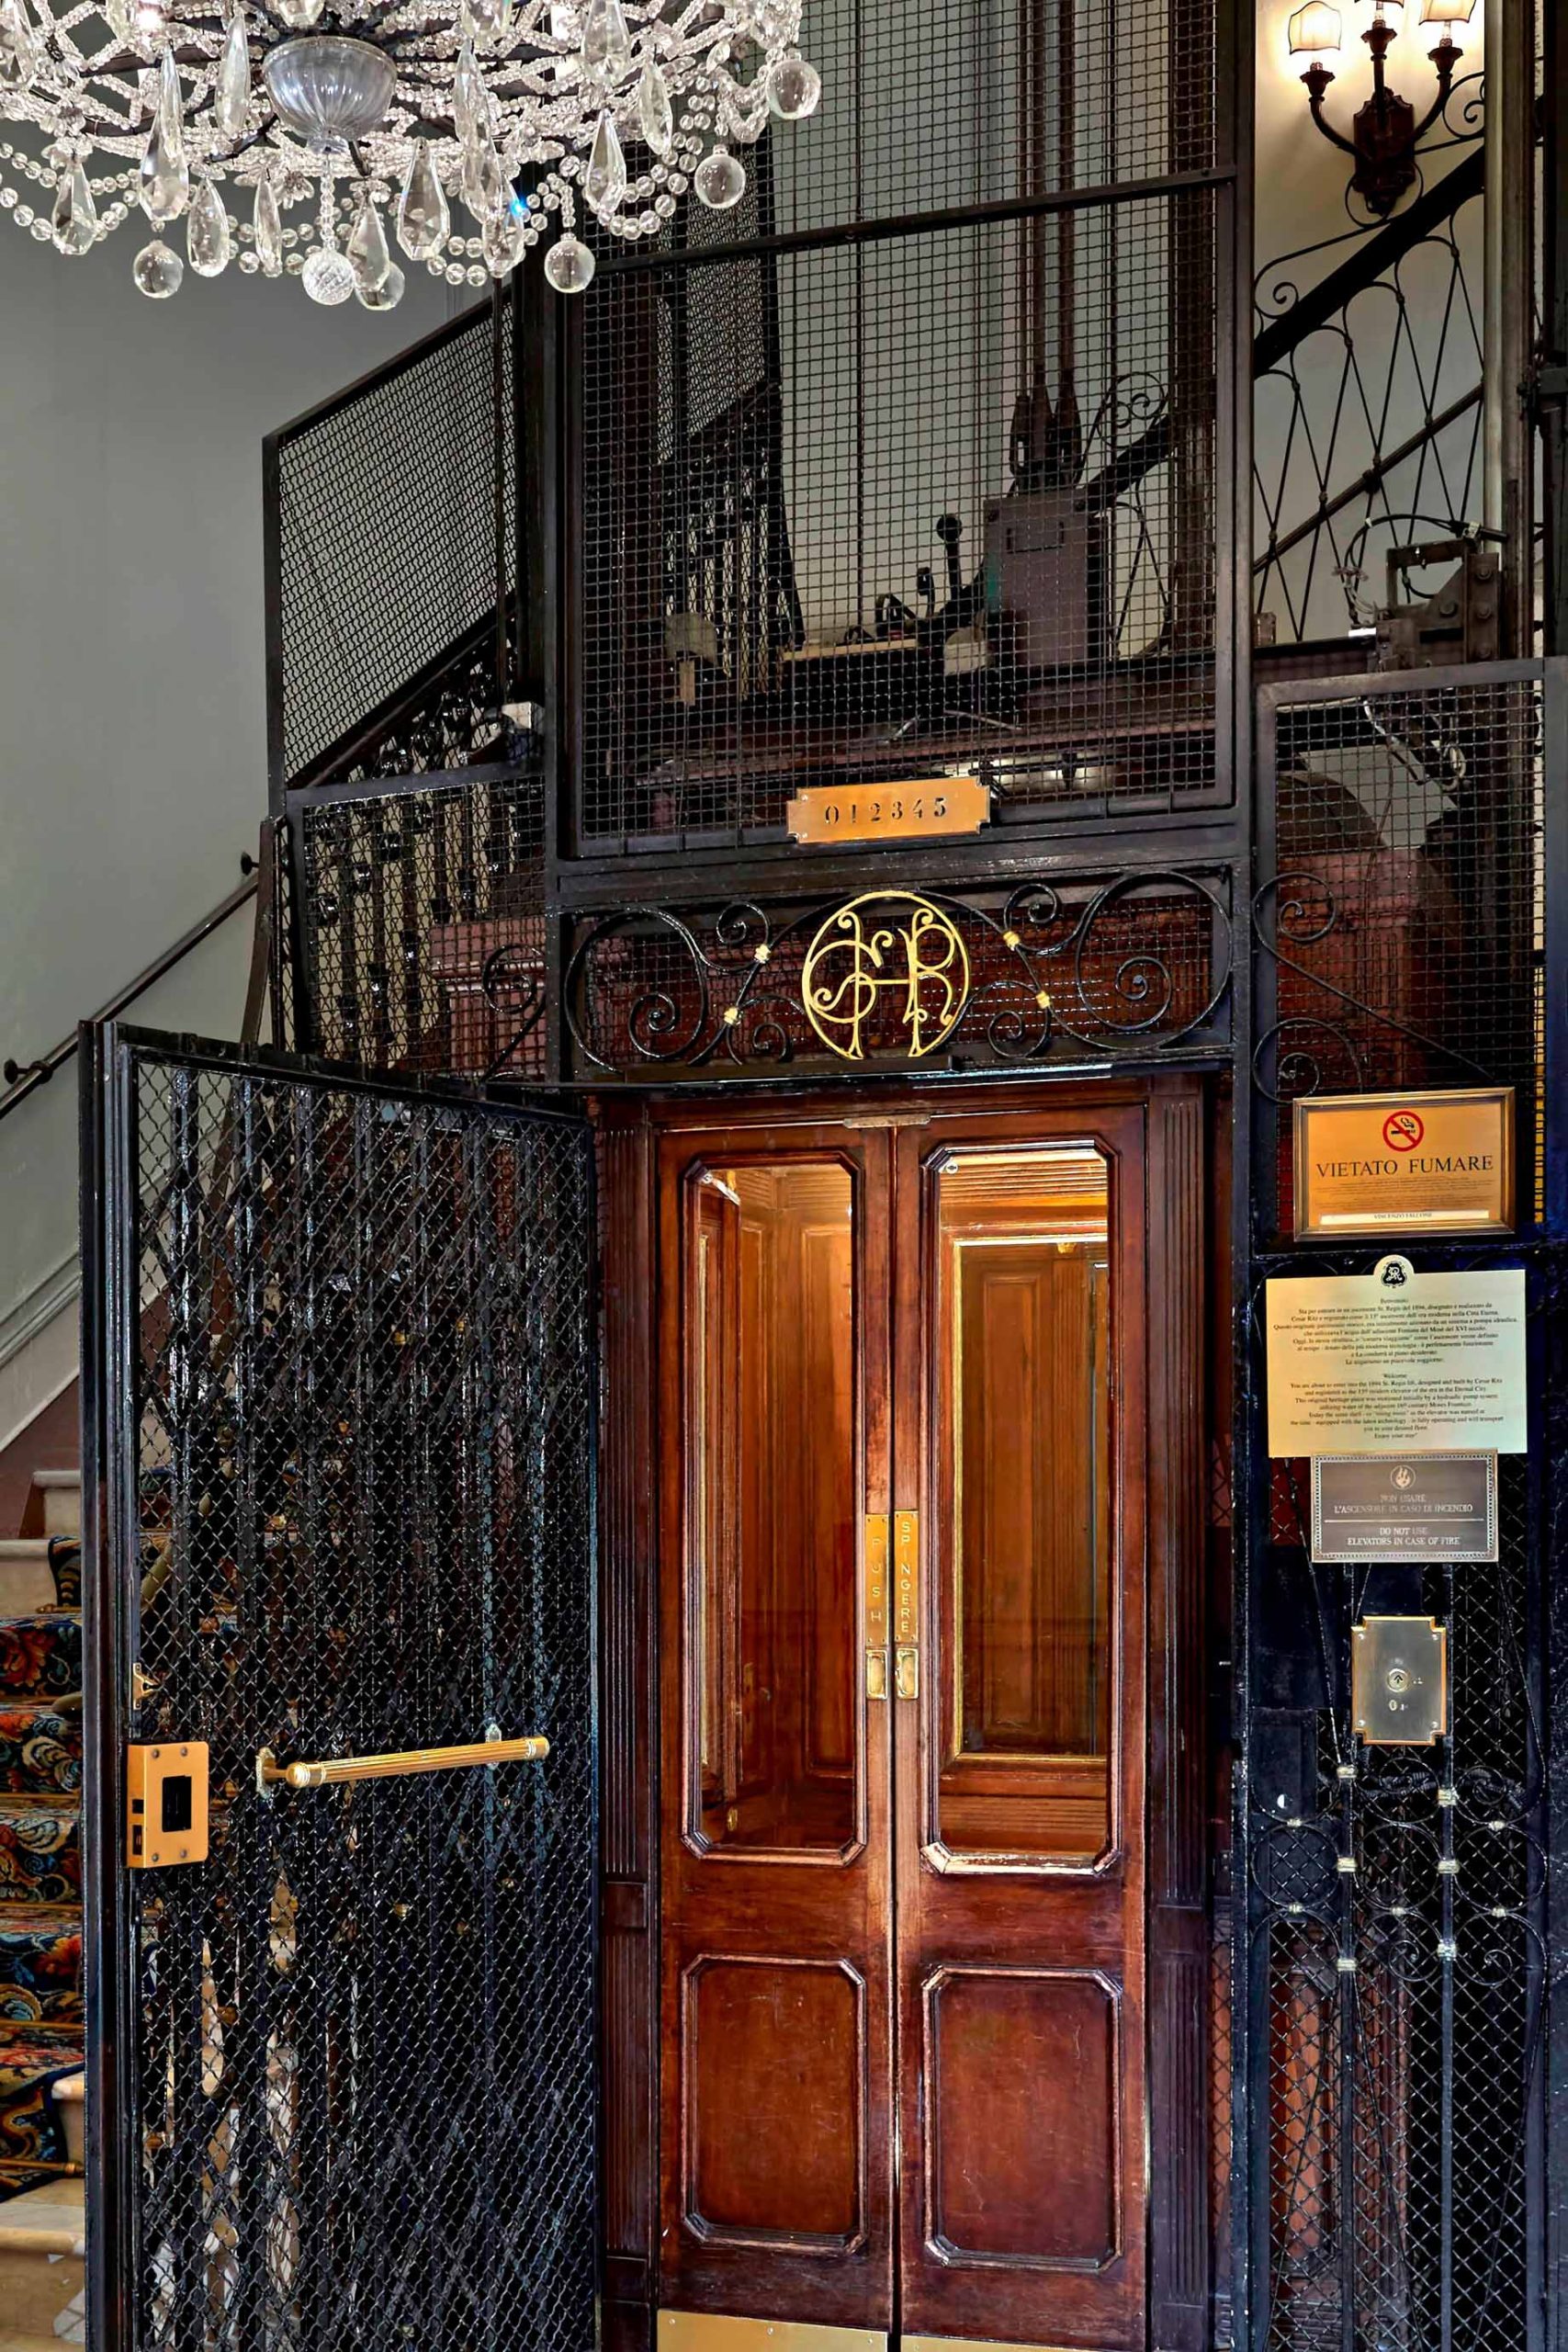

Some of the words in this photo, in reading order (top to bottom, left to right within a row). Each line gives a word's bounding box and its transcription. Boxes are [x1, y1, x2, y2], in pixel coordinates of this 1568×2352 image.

[1316, 1159, 1398, 1178] VIETATO
[1409, 1155, 1494, 1174] FUMARE
[1381, 1494, 1397, 1502] NON
[1400, 1494, 1426, 1502] USARE
[1334, 1505, 1386, 1514] L'ASCENSORE
[1389, 1505, 1398, 1513] IN
[1401, 1505, 1421, 1513] CASO
[1424, 1504, 1433, 1512] DI
[1435, 1504, 1472, 1512] INCENDIO
[1393, 1527, 1410, 1535] NOT
[1412, 1527, 1427, 1535] USE
[1348, 1537, 1393, 1545] ELEVATORS
[1394, 1537, 1404, 1545] IN
[1405, 1537, 1426, 1545] CASE
[1428, 1537, 1439, 1545] OF
[1441, 1536, 1461, 1544] FIRE
[871, 1537, 882, 1623] PUSH
[900, 1521, 911, 1633] SPINGERE
